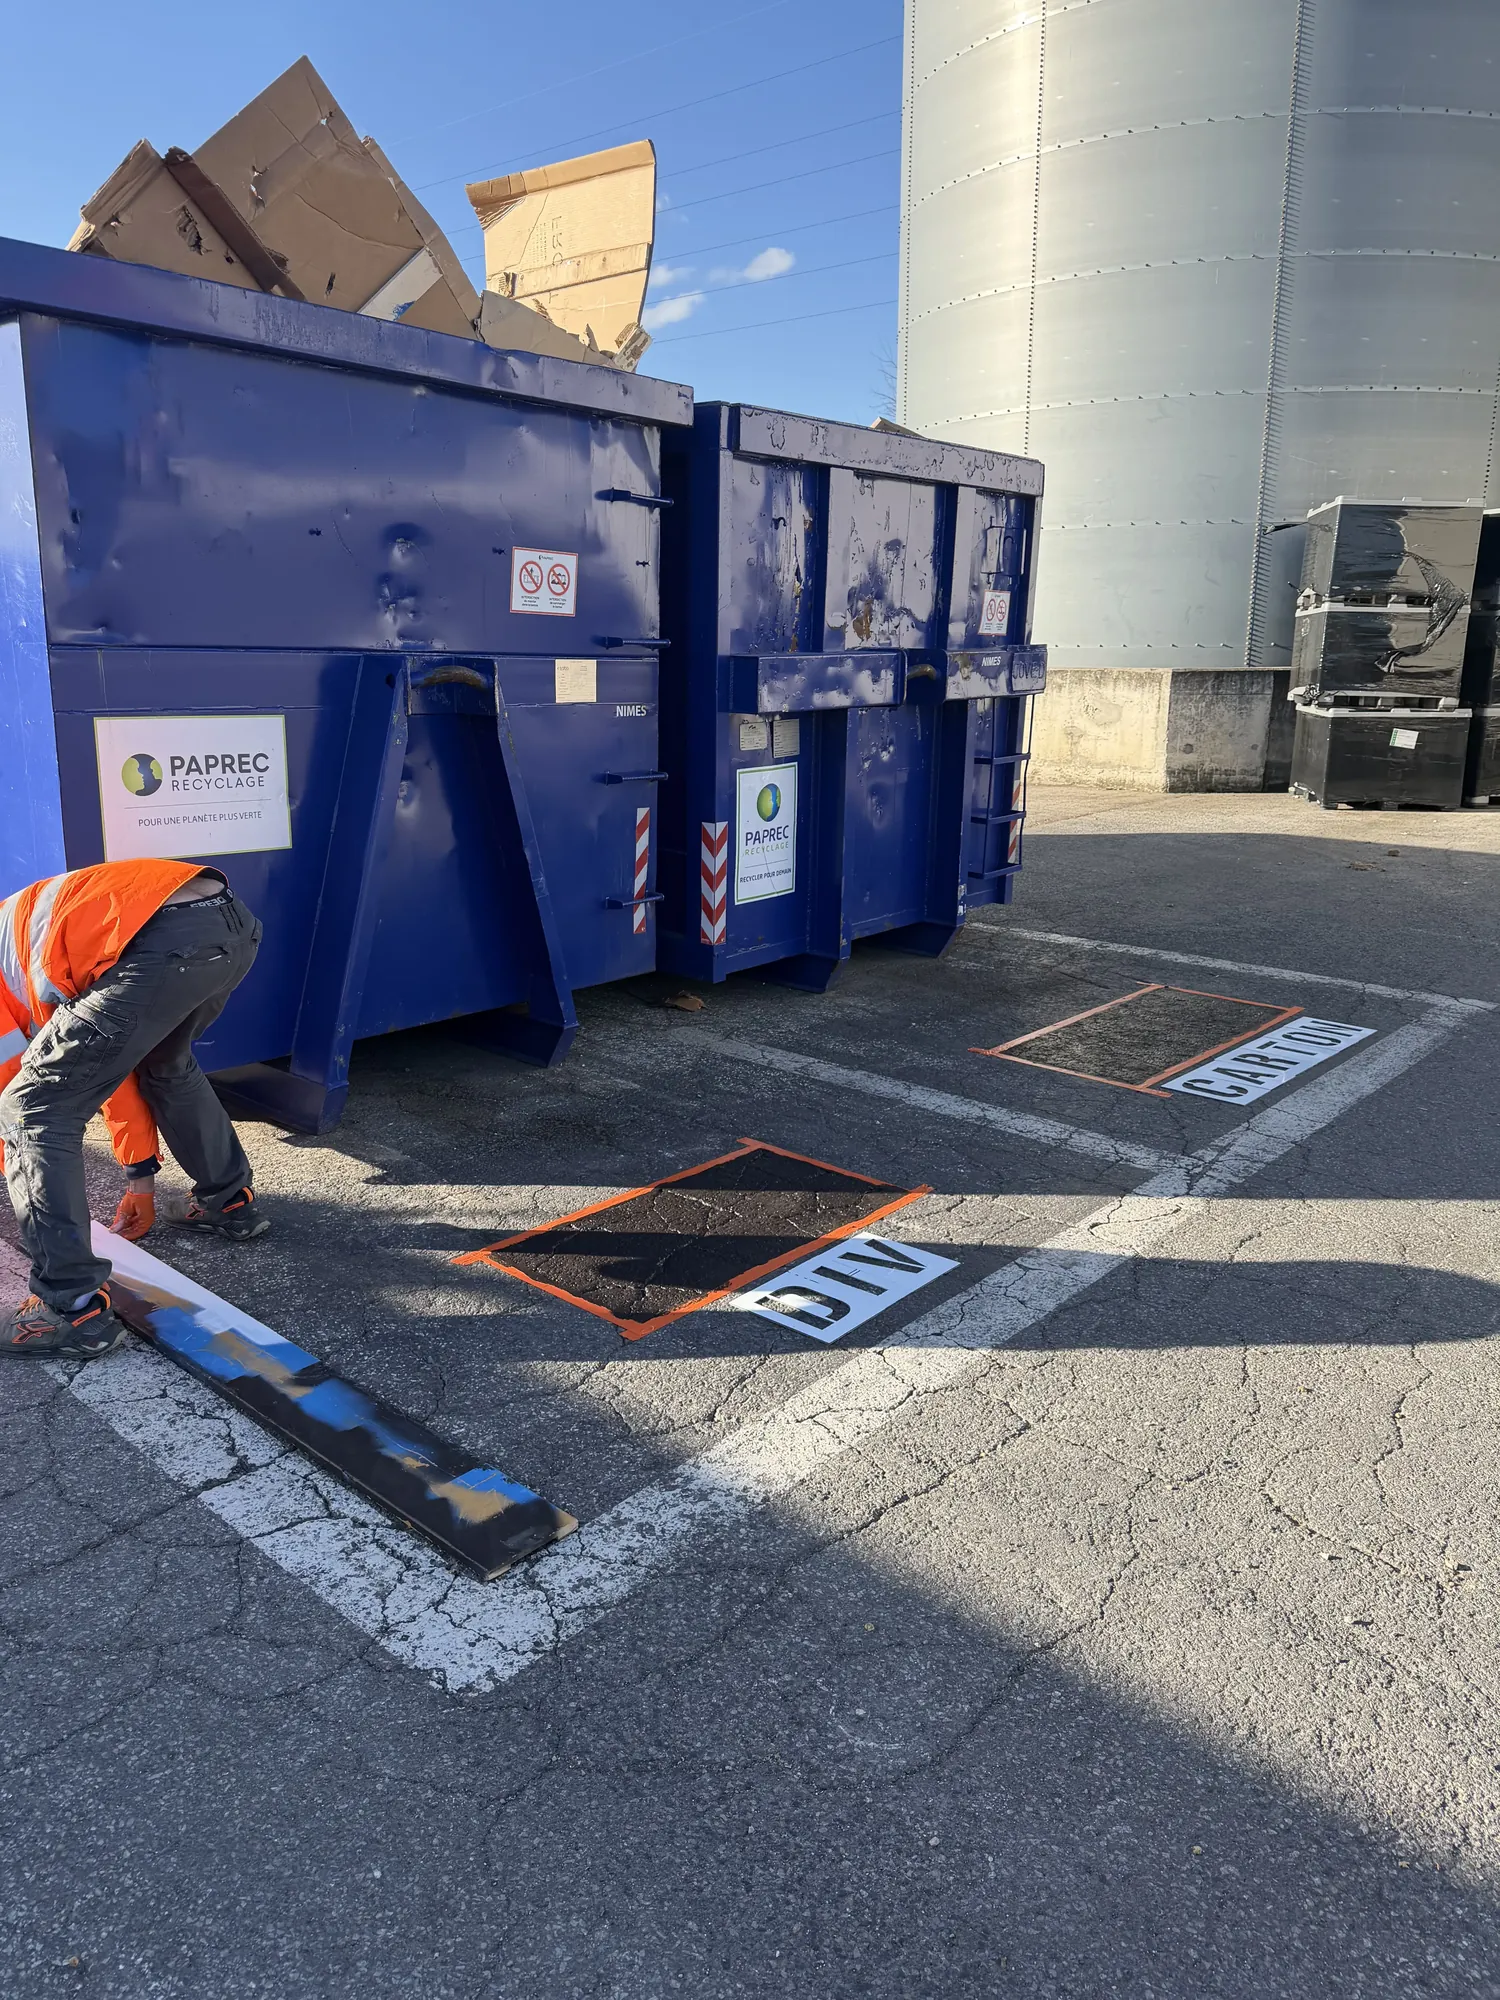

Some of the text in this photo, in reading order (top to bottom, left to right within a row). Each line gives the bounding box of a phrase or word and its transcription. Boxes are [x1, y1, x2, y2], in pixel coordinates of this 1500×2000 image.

[981, 656, 1002, 667] NIMES
[616, 705, 647, 717] NIMES
[169, 753, 270, 776] PAPREC
[171, 776, 265, 791] RECYCLAGE
[138, 811, 262, 827] POUR UNE PLANÈTE PLUS VERTE
[745, 825, 789, 846] PAPREC
[744, 841, 789, 856] RECYCLAGE
[740, 868, 792, 883] RECYCLER POUR DEMAIN
[1181, 1020, 1363, 1098] CARTON
[754, 1238, 926, 1331] DIV
